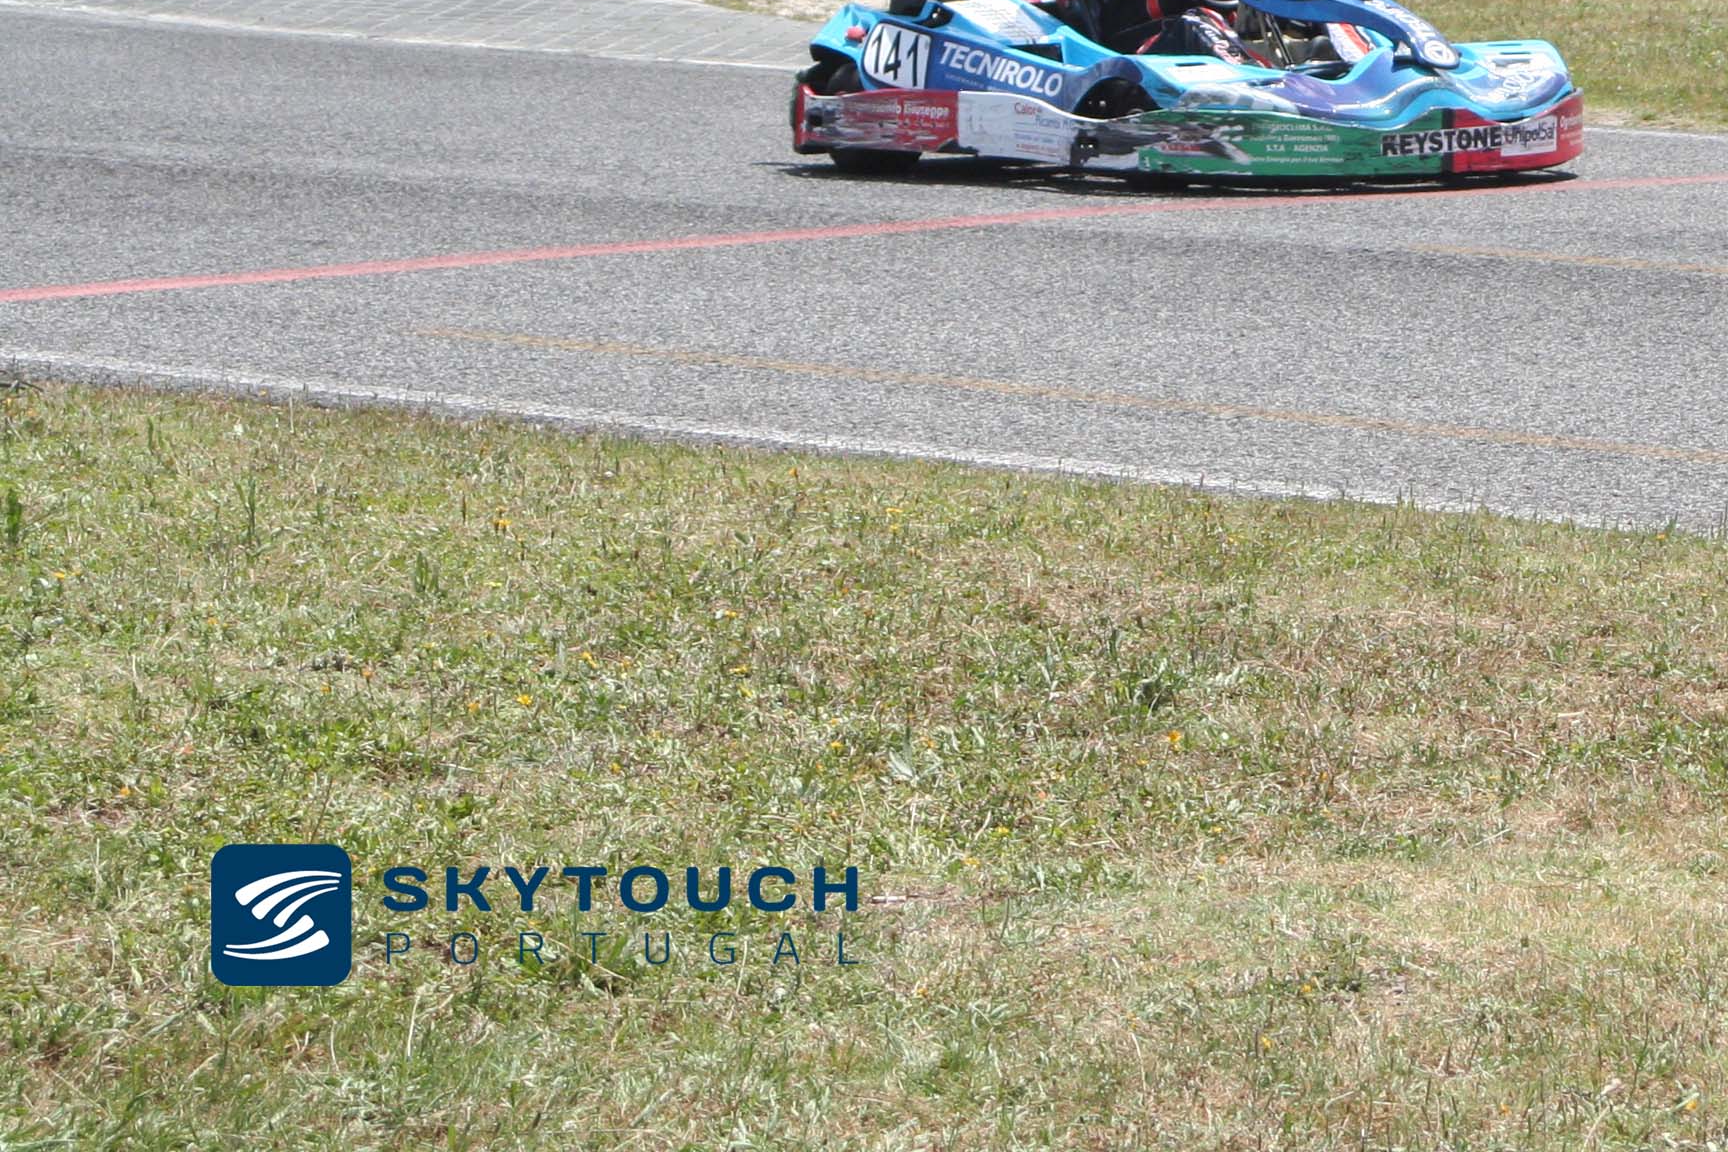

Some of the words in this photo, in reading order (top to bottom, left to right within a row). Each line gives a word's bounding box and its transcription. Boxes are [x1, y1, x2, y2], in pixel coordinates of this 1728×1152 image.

[868, 24, 921, 88] 141
[939, 41, 1064, 98] TECNIROLO
[1381, 126, 1503, 157] KEYSTONE
